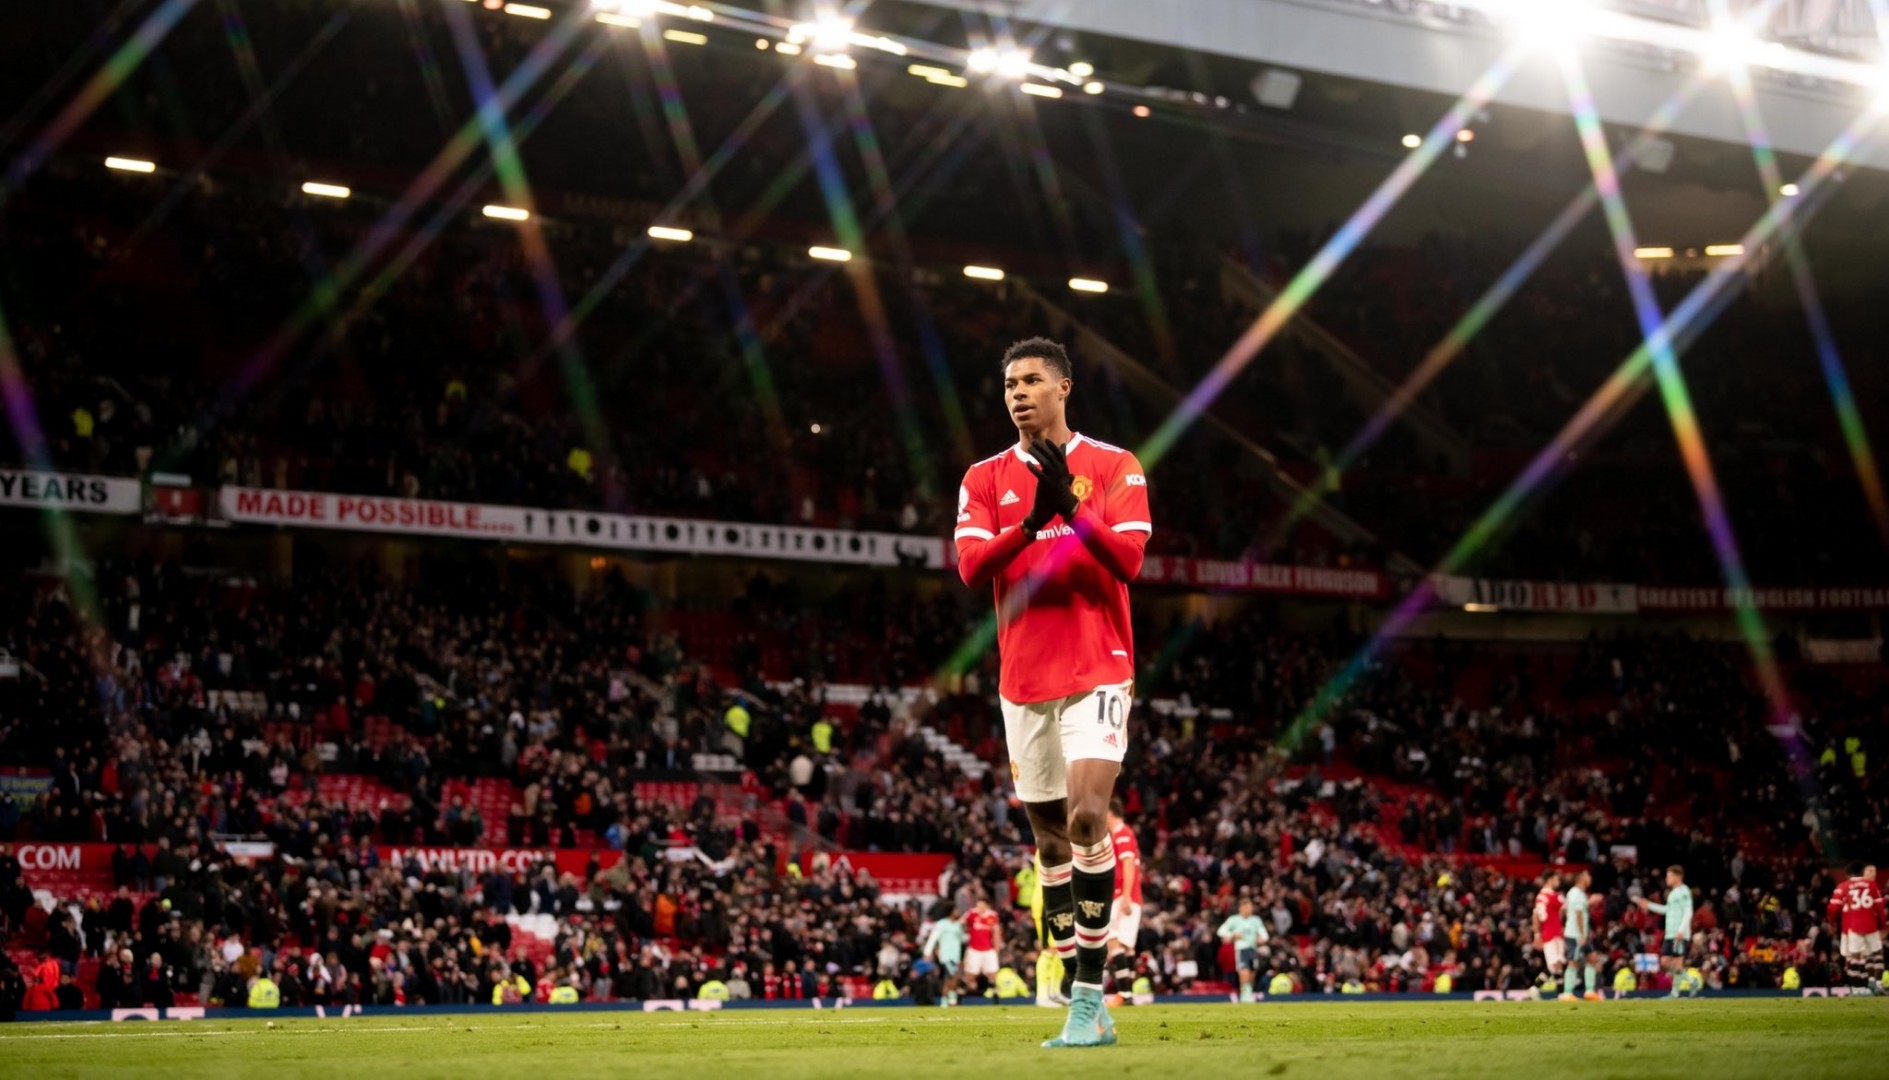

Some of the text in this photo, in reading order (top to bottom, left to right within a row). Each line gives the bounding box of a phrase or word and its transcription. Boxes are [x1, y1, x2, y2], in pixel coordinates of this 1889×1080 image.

[0, 473, 108, 503] YEARS
[237, 489, 326, 518] MADE
[1819, 588, 1889, 607] FOOTBA
[1096, 690, 1124, 731] 10
[17, 844, 82, 871] COM
[1848, 887, 1874, 910] 36
